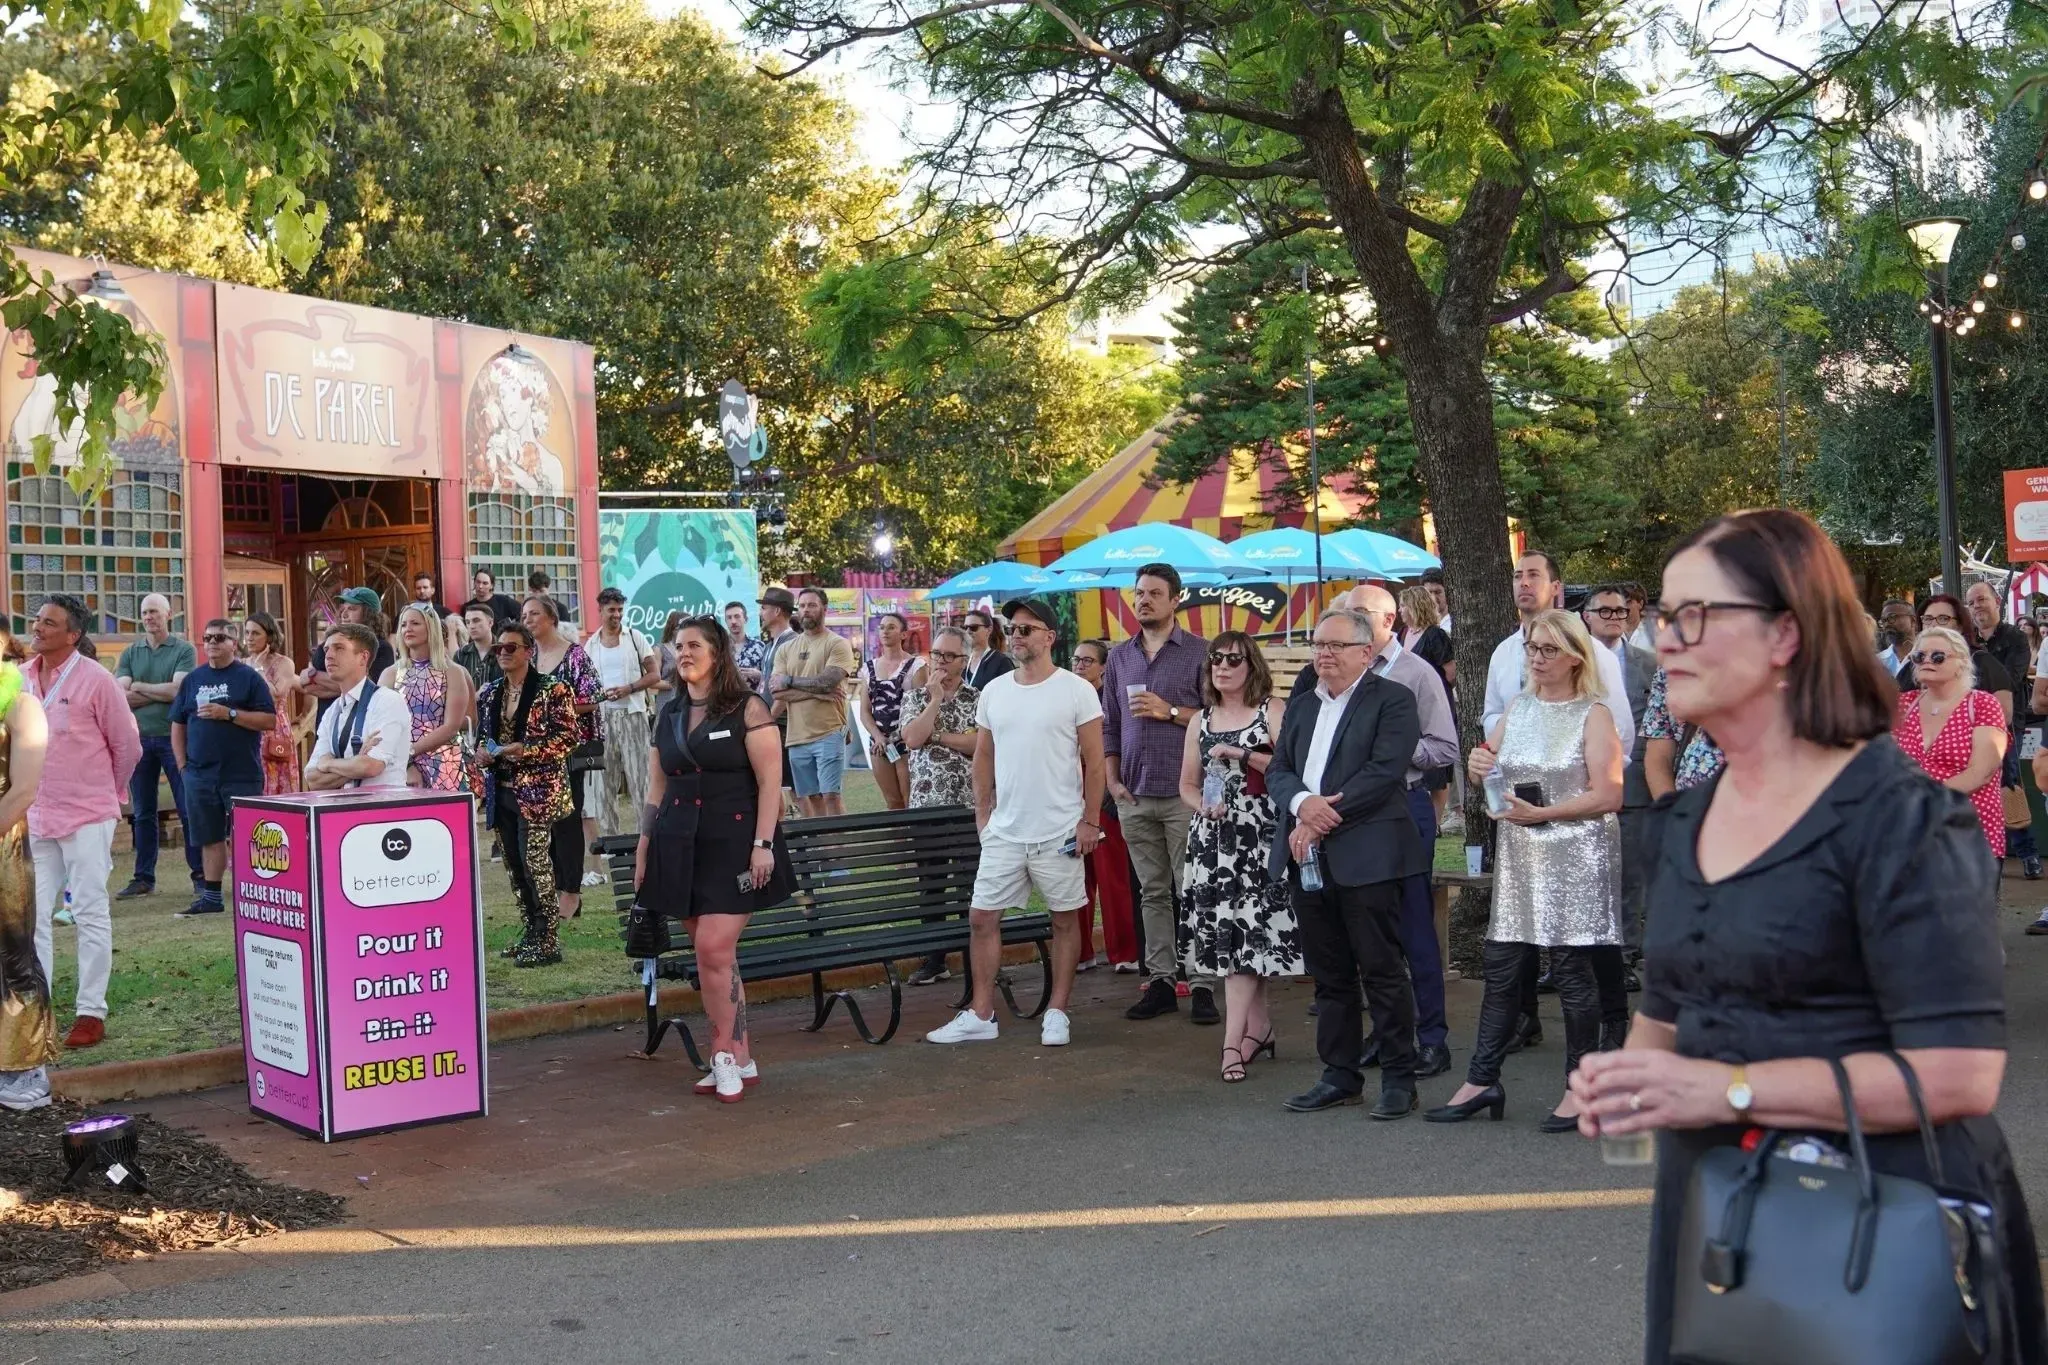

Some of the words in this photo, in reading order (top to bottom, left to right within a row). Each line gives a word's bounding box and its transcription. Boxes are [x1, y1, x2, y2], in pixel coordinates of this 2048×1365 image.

[264, 371, 306, 440] DE
[314, 376, 402, 448] PAREL
[668, 595, 684, 604] THE
[249, 841, 290, 872] WORLD
[240, 881, 268, 902] PLEASE
[269, 886, 304, 909] RETURN
[239, 901, 260, 920] YOUR
[260, 905, 282, 926] CUPS
[283, 910, 306, 930] HERE
[357, 932, 418, 957] Pour
[424, 926, 443, 950] it
[265, 958, 278, 970] ONLY
[354, 971, 424, 1001] Drink
[430, 967, 449, 992] it
[366, 1017, 407, 1043] Bin
[415, 1011, 433, 1036] it
[344, 1054, 426, 1090] REUSE
[433, 1050, 466, 1078] IT.
